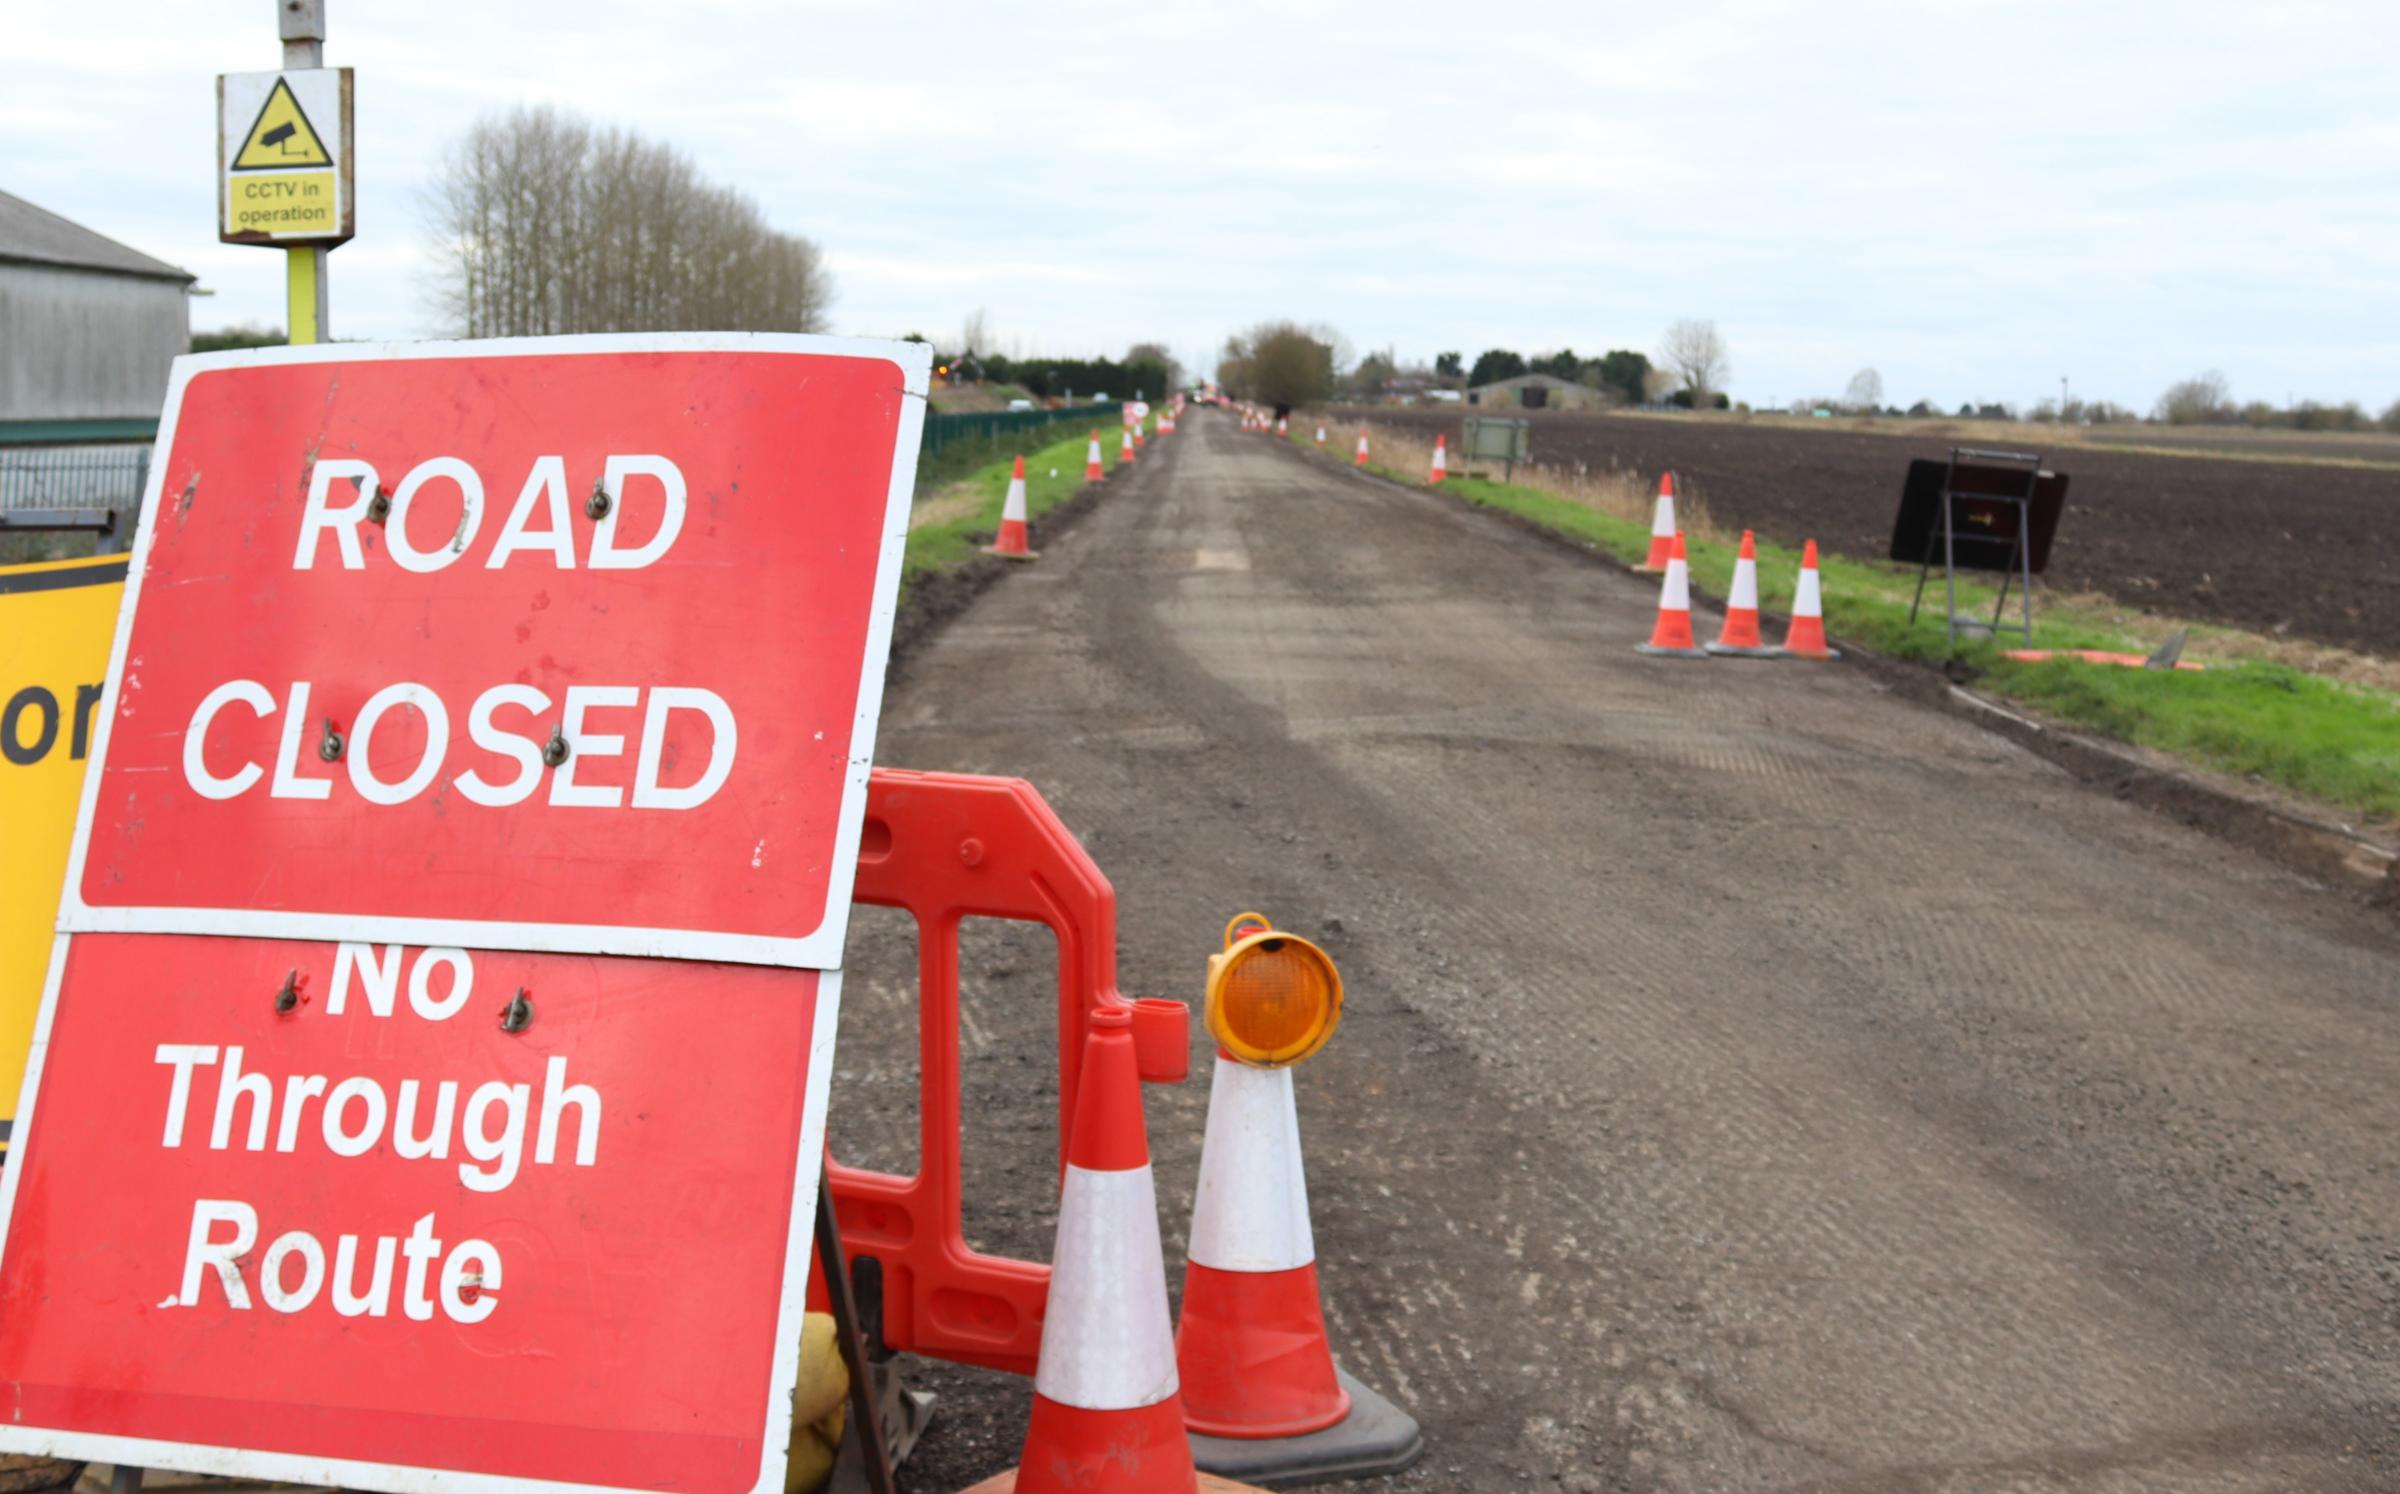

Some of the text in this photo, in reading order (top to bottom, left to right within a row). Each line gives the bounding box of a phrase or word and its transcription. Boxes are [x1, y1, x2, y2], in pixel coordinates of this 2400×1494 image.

[240, 206, 325, 225] operation
[246, 181, 319, 199] CCTV in
[292, 453, 688, 574] ROAD
[182, 679, 738, 811] CLOSED
[326, 942, 474, 1022] No
[154, 1043, 603, 1193] Through
[178, 1198, 503, 1325] Route
